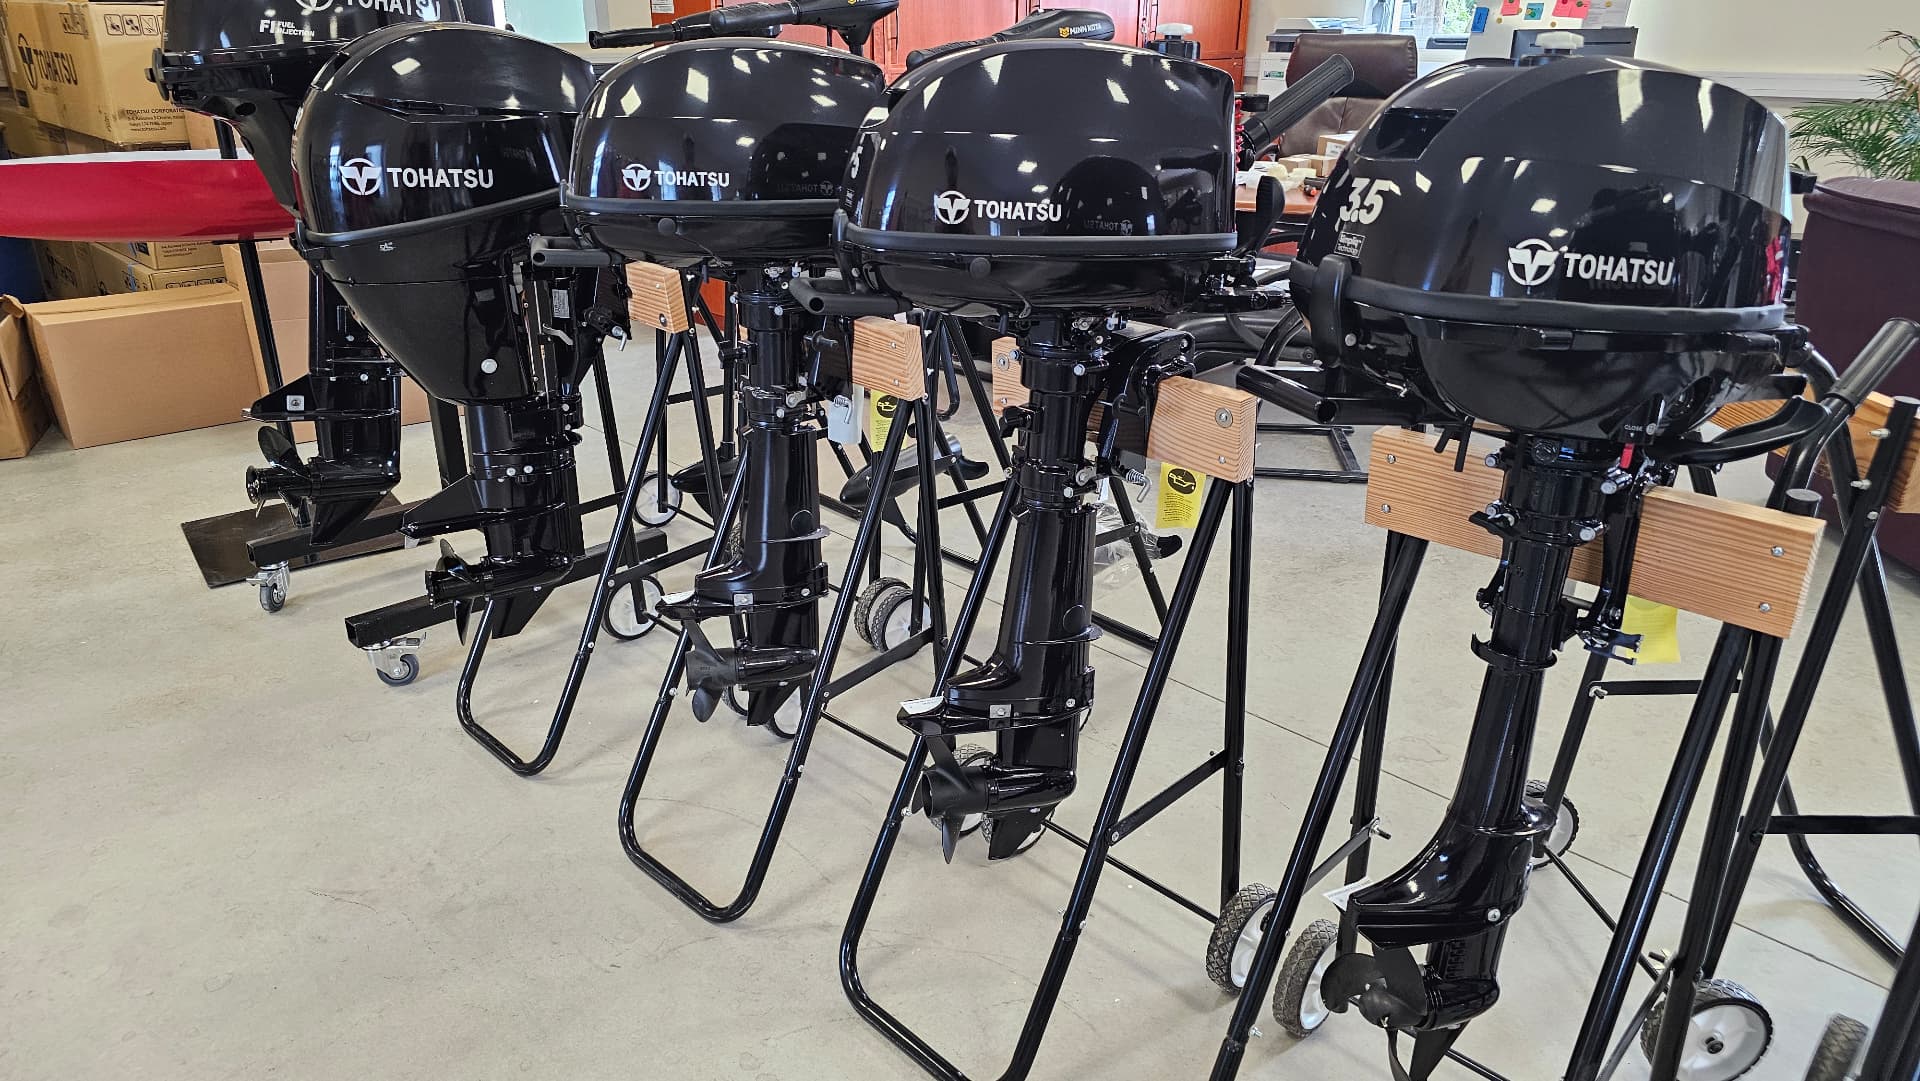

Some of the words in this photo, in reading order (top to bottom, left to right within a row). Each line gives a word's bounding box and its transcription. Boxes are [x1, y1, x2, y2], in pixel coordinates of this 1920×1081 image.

[347, 0, 441, 21] HATSU
[1070, 25, 1087, 35] MINN
[386, 167, 494, 189] TOHATSU
[654, 165, 730, 187] TOHATSU
[974, 199, 1062, 222] TOHATSU
[1563, 252, 1675, 286] TOHATSU
